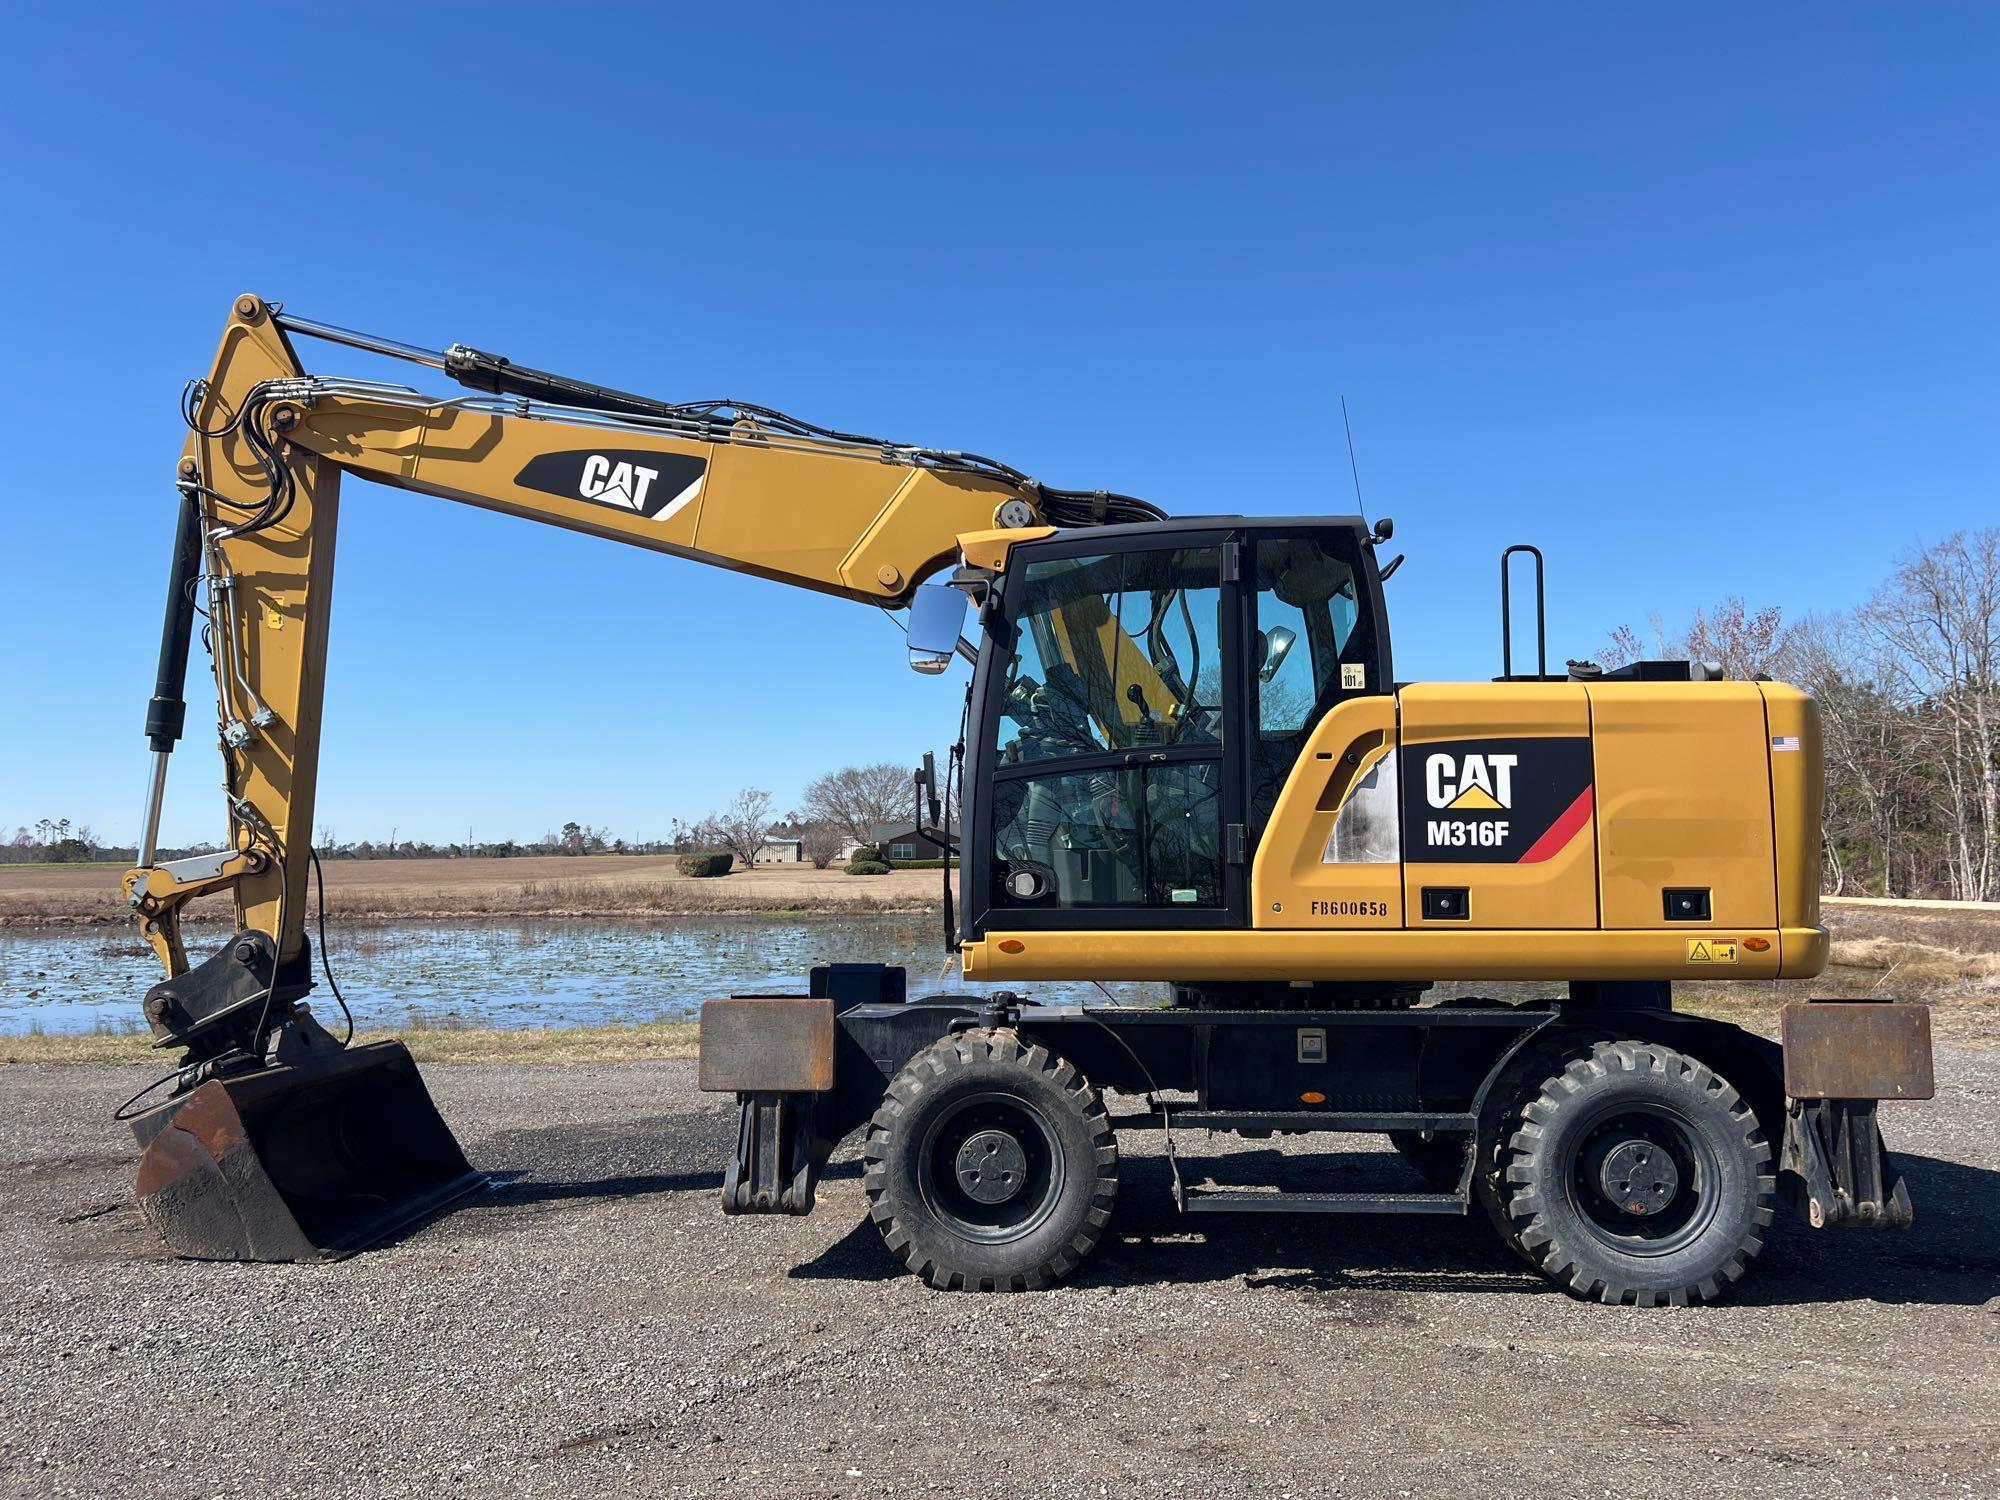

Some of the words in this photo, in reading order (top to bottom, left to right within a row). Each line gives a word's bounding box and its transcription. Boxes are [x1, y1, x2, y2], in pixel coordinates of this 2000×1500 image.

[579, 454, 659, 511] CAT
[1344, 675, 1356, 687] 101
[1426, 753, 1518, 809] CAT
[1427, 821, 1509, 847] M316F
[1311, 901, 1388, 917] FB600658
